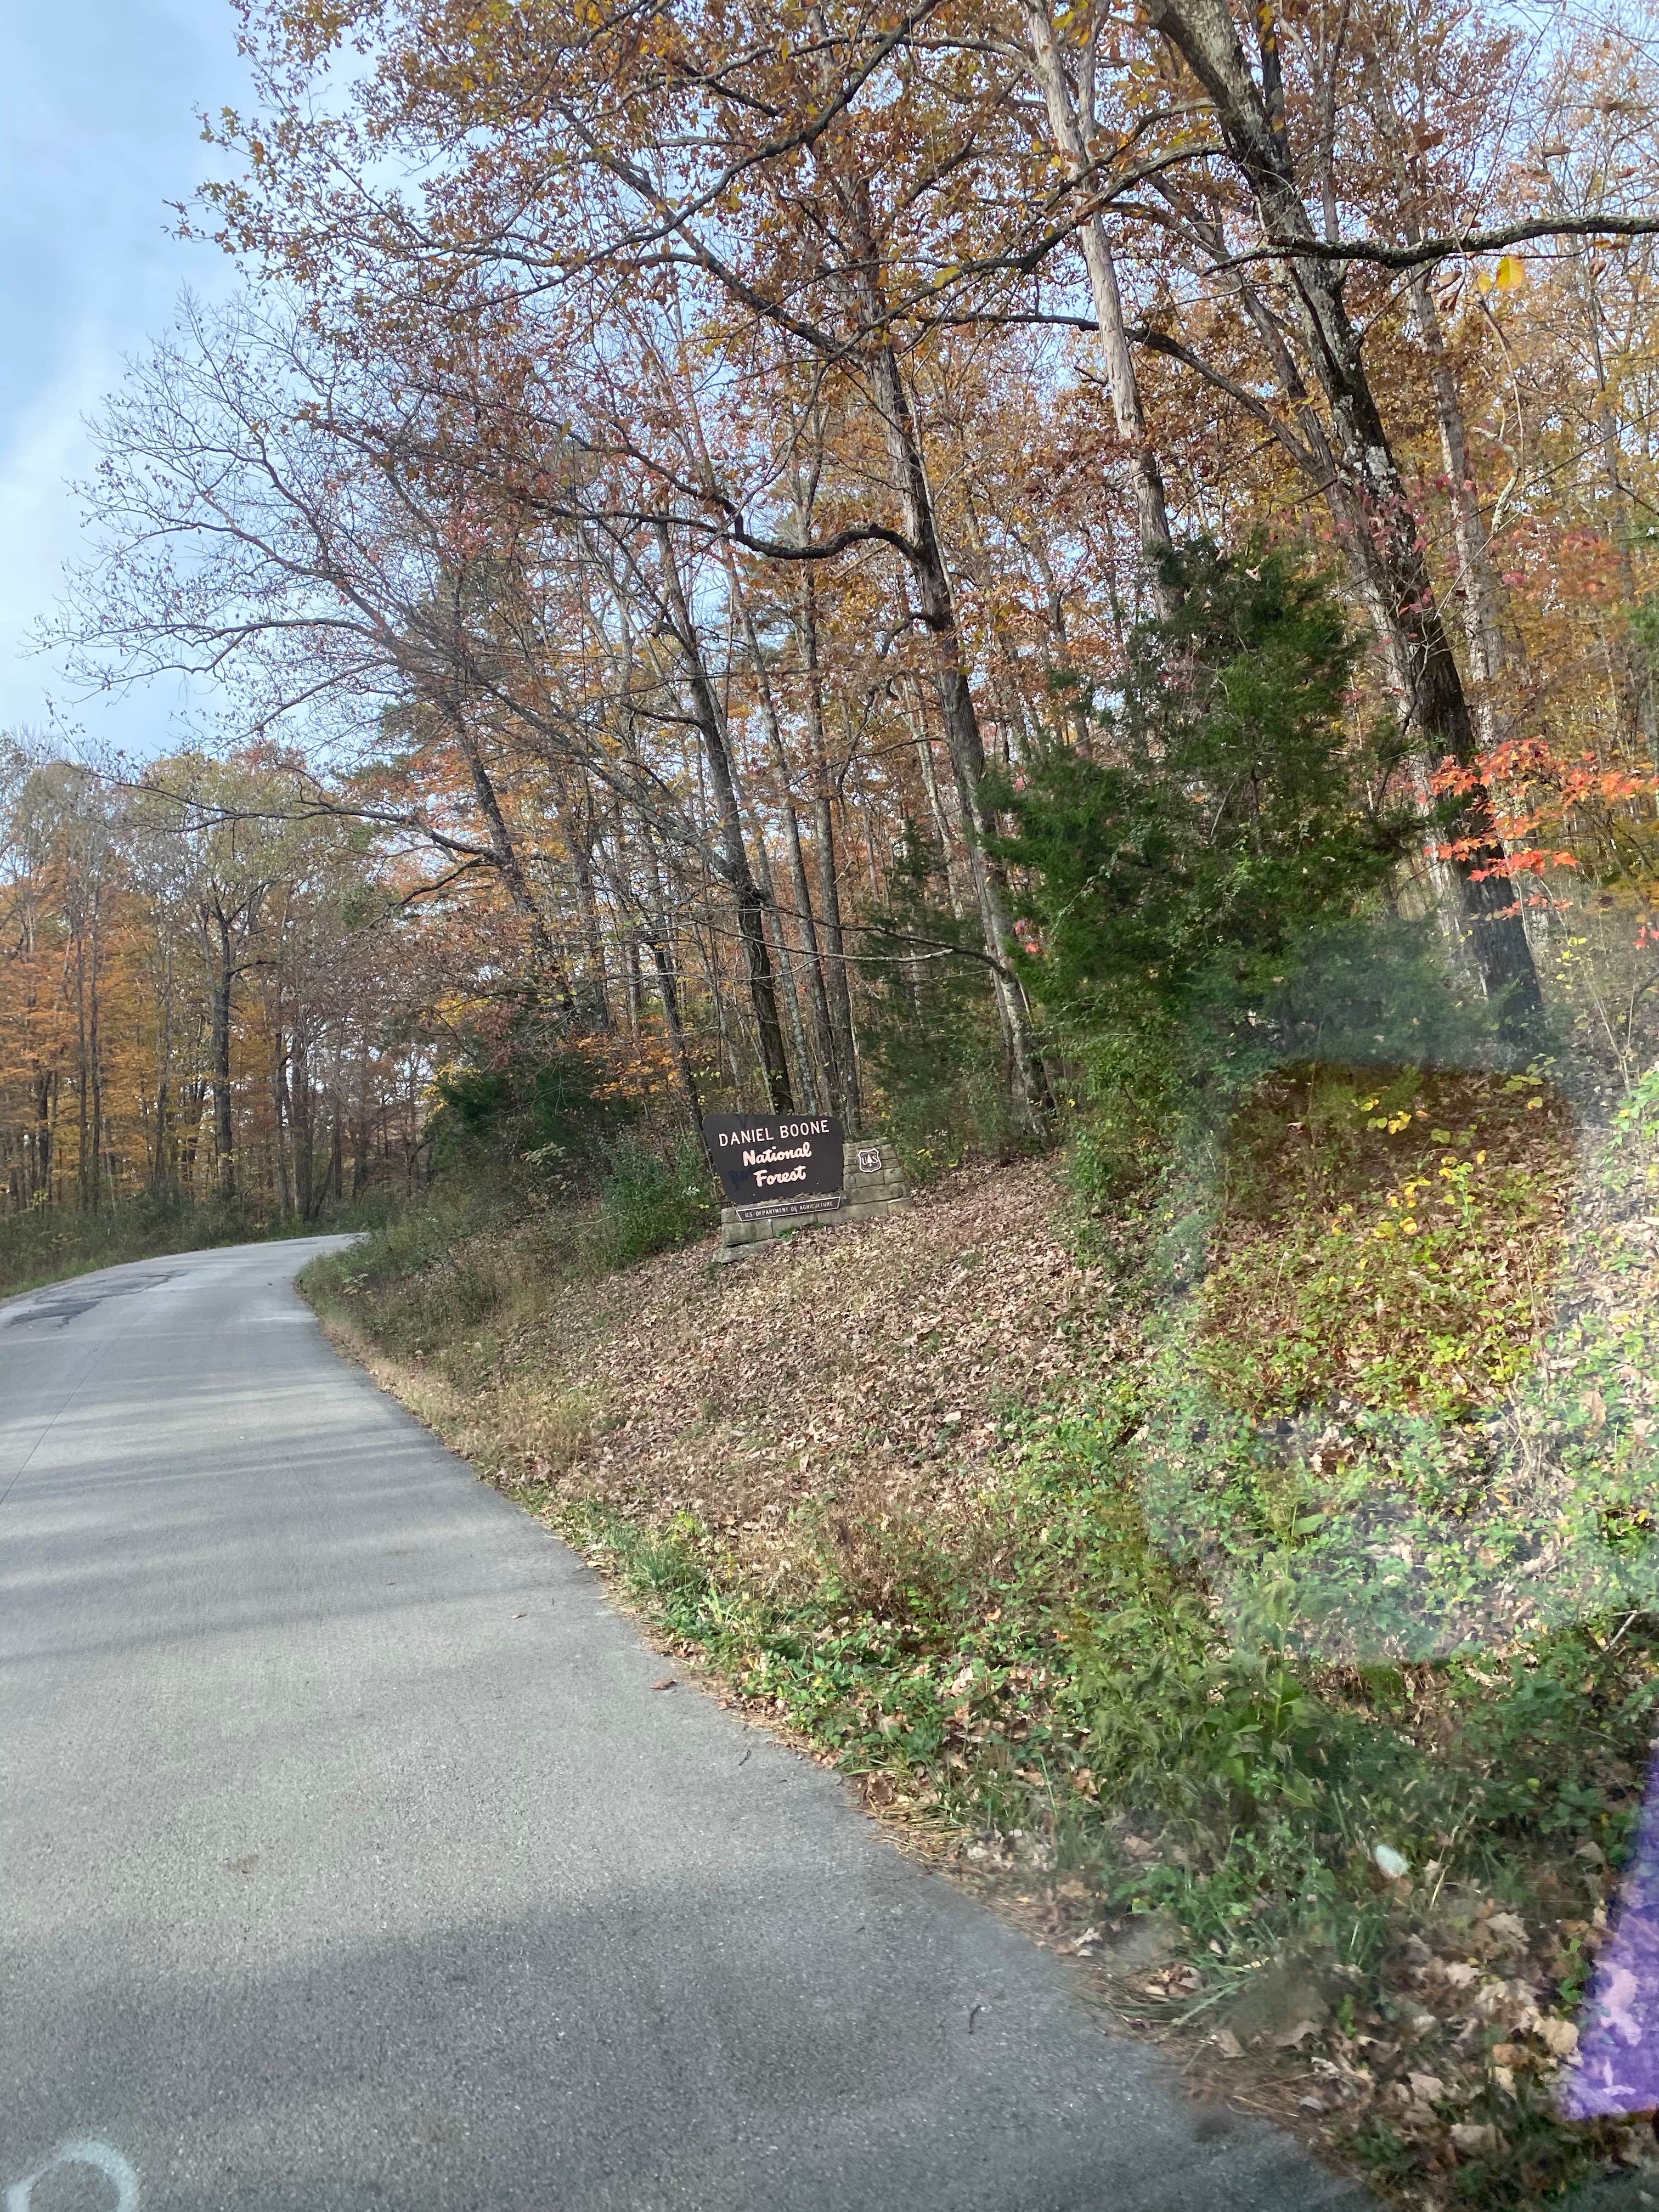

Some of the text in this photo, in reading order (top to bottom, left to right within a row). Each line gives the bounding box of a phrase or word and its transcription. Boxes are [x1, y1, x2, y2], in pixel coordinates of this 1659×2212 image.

[719, 1120, 830, 1147] DANIEL BOONE
[742, 1141, 812, 1166] National
[753, 1165, 806, 1187] Forest
[755, 1207, 788, 1216] DEPARTMENT
[799, 1201, 833, 1210] AGRICULTURE
